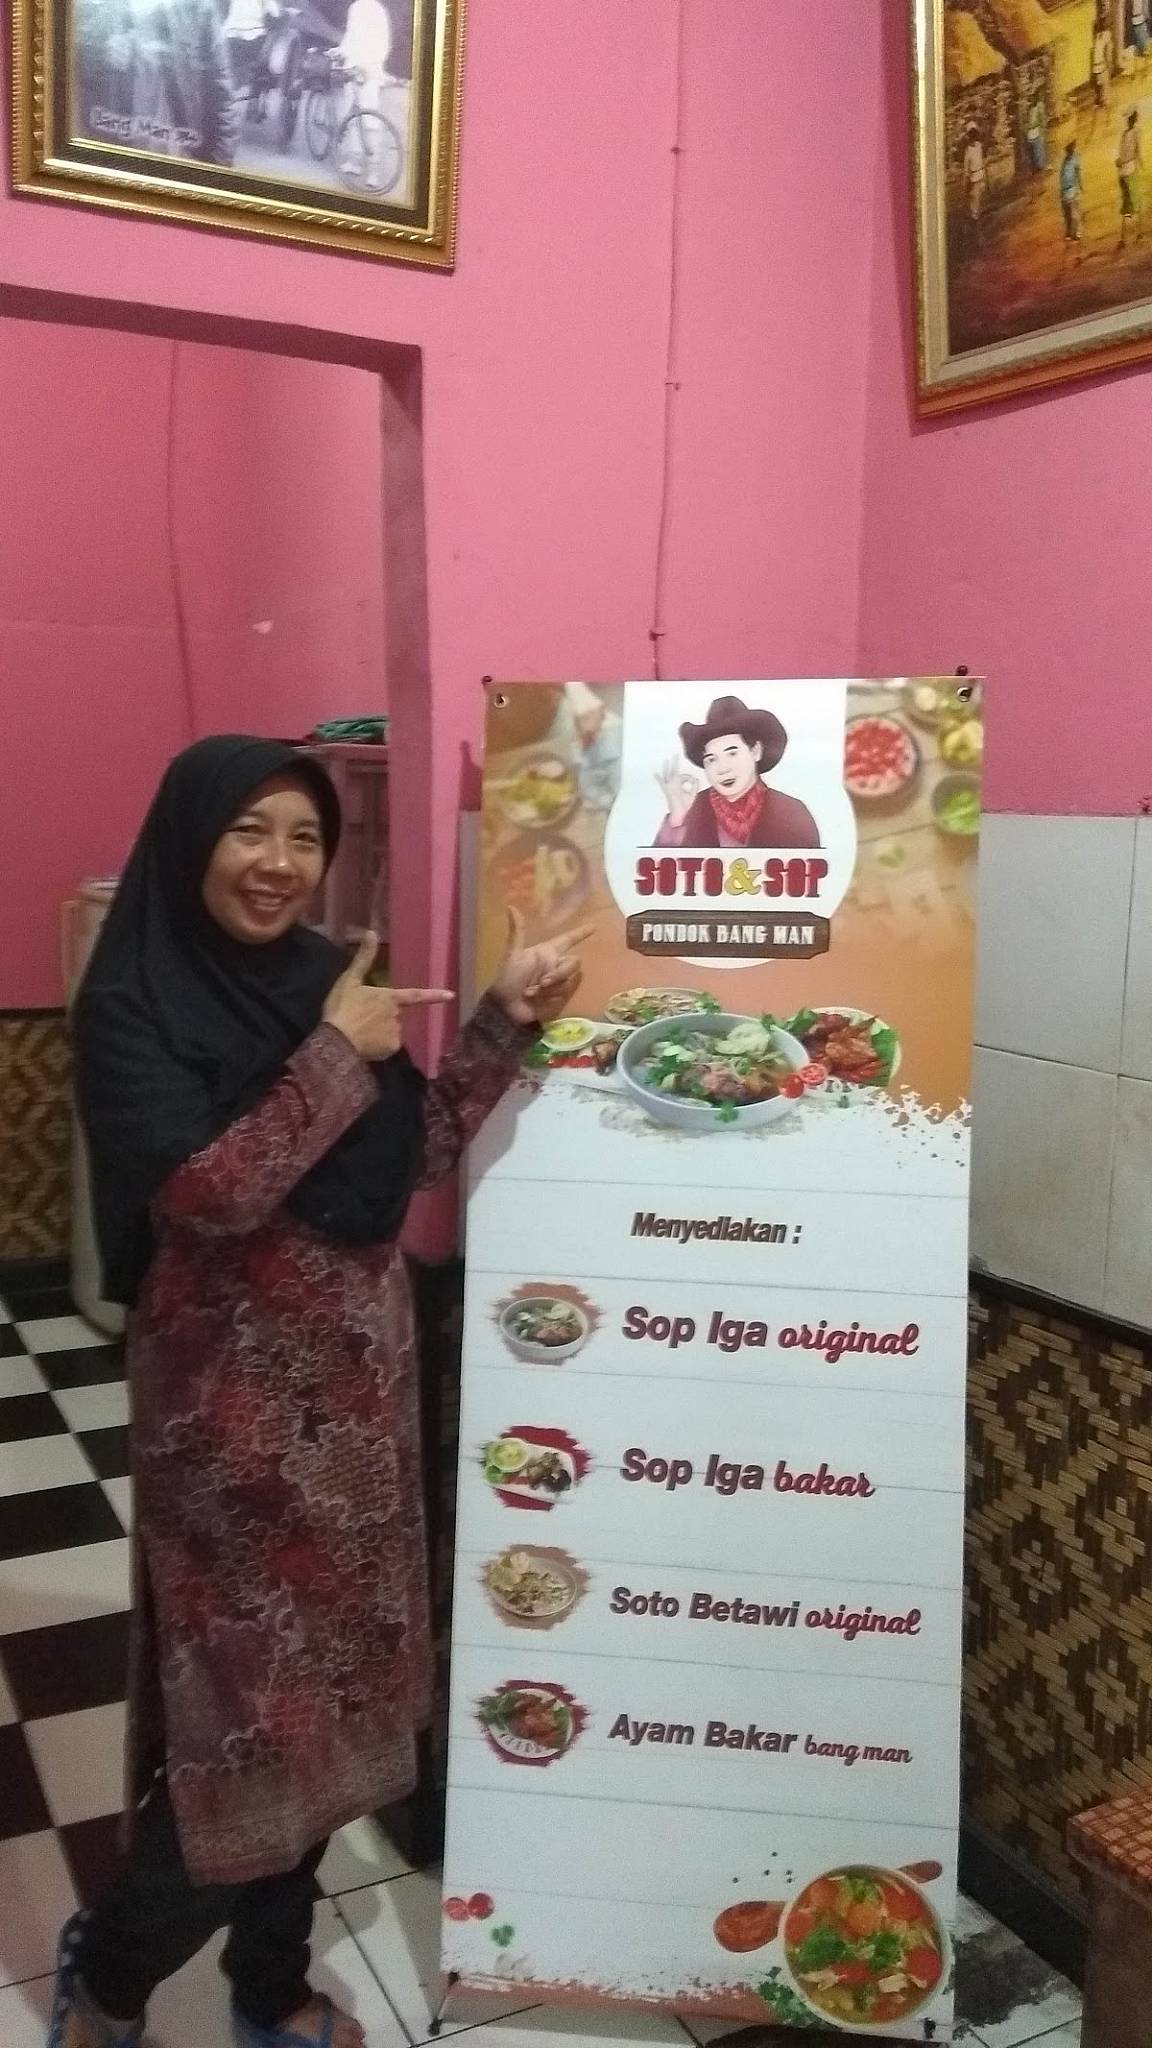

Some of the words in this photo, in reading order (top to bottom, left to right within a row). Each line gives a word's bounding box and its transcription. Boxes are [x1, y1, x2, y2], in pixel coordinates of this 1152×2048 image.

[642, 924, 710, 942] PONDOK
[716, 925, 768, 944] BANG
[773, 926, 816, 945] MAN
[631, 1213, 787, 1244] Menyediakan
[621, 1306, 696, 1349] Sop
[706, 1311, 768, 1353] Iga
[778, 1320, 920, 1364] original
[620, 1448, 693, 1490] Sop
[704, 1455, 764, 1495] Iga
[773, 1460, 875, 1498] bakar
[609, 1587, 680, 1618] Soto
[688, 1592, 800, 1627] Betawi
[805, 1605, 921, 1641] original
[608, 1713, 694, 1745] Ayam
[704, 1721, 798, 1754] Bakar
[805, 1735, 860, 1766] bang
[862, 1745, 912, 1764] man
